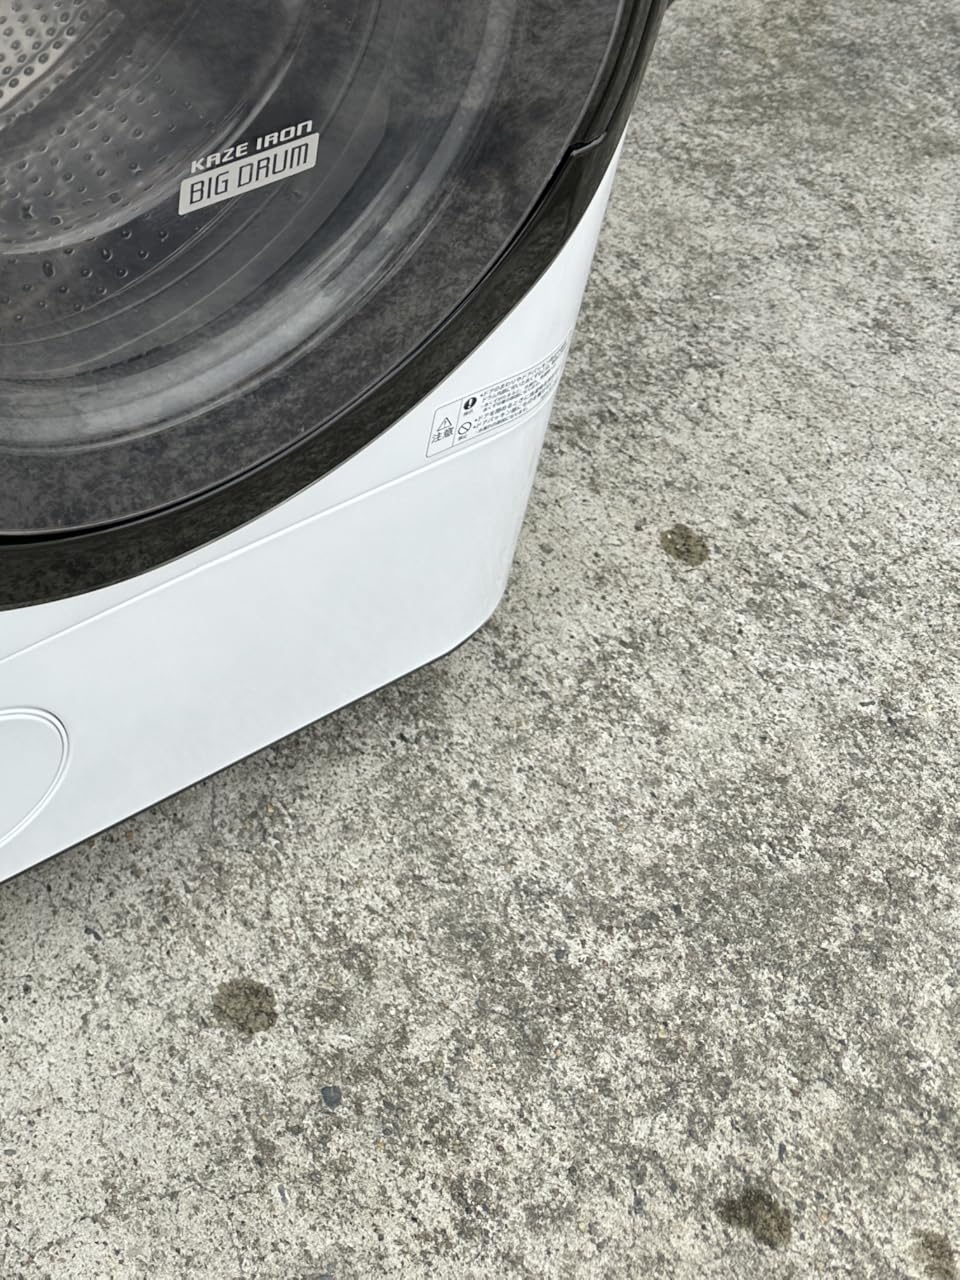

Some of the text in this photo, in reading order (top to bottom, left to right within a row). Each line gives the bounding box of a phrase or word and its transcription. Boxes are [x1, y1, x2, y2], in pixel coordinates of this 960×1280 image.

[190, 119, 313, 174] KAZE IRON
[190, 142, 309, 205] BIG DRUM
